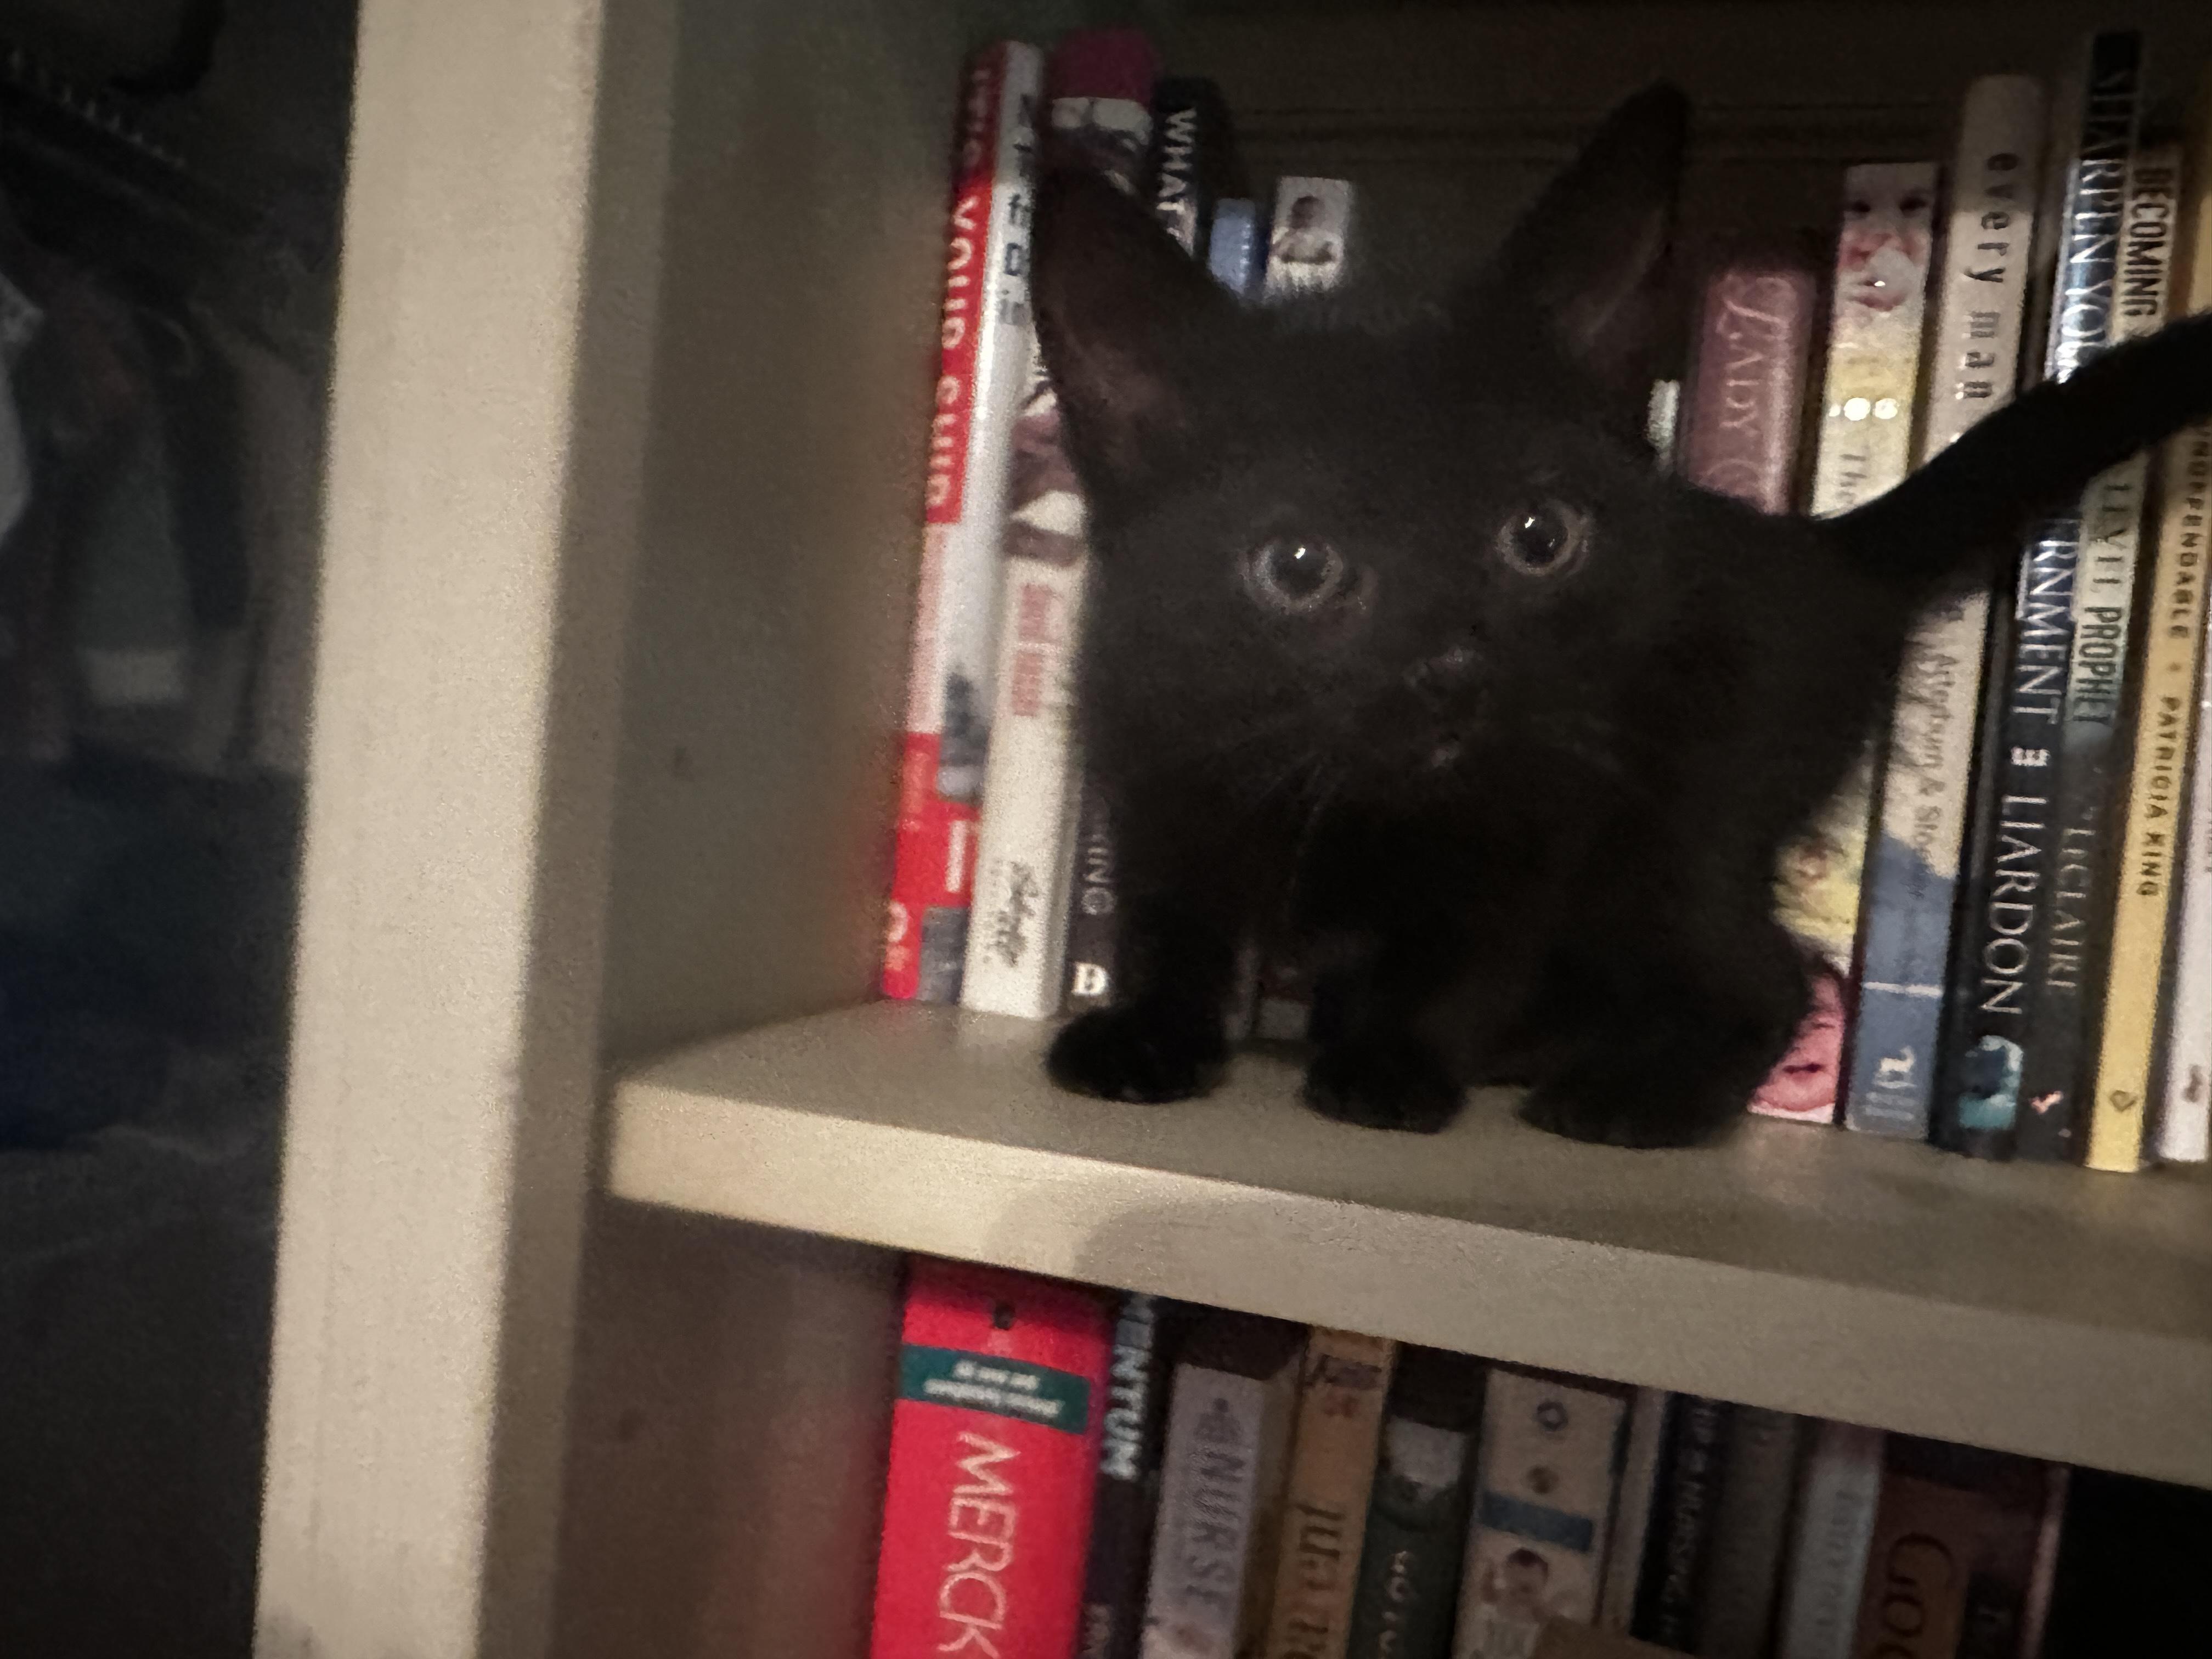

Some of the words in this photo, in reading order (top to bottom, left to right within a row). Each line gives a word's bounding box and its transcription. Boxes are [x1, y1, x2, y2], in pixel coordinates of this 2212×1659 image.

[1967, 153, 2021, 284] every
[1961, 310, 2002, 400] man
[1978, 794, 2051, 1015] LIARDON
[936, 1429, 1022, 1659] MERCK
